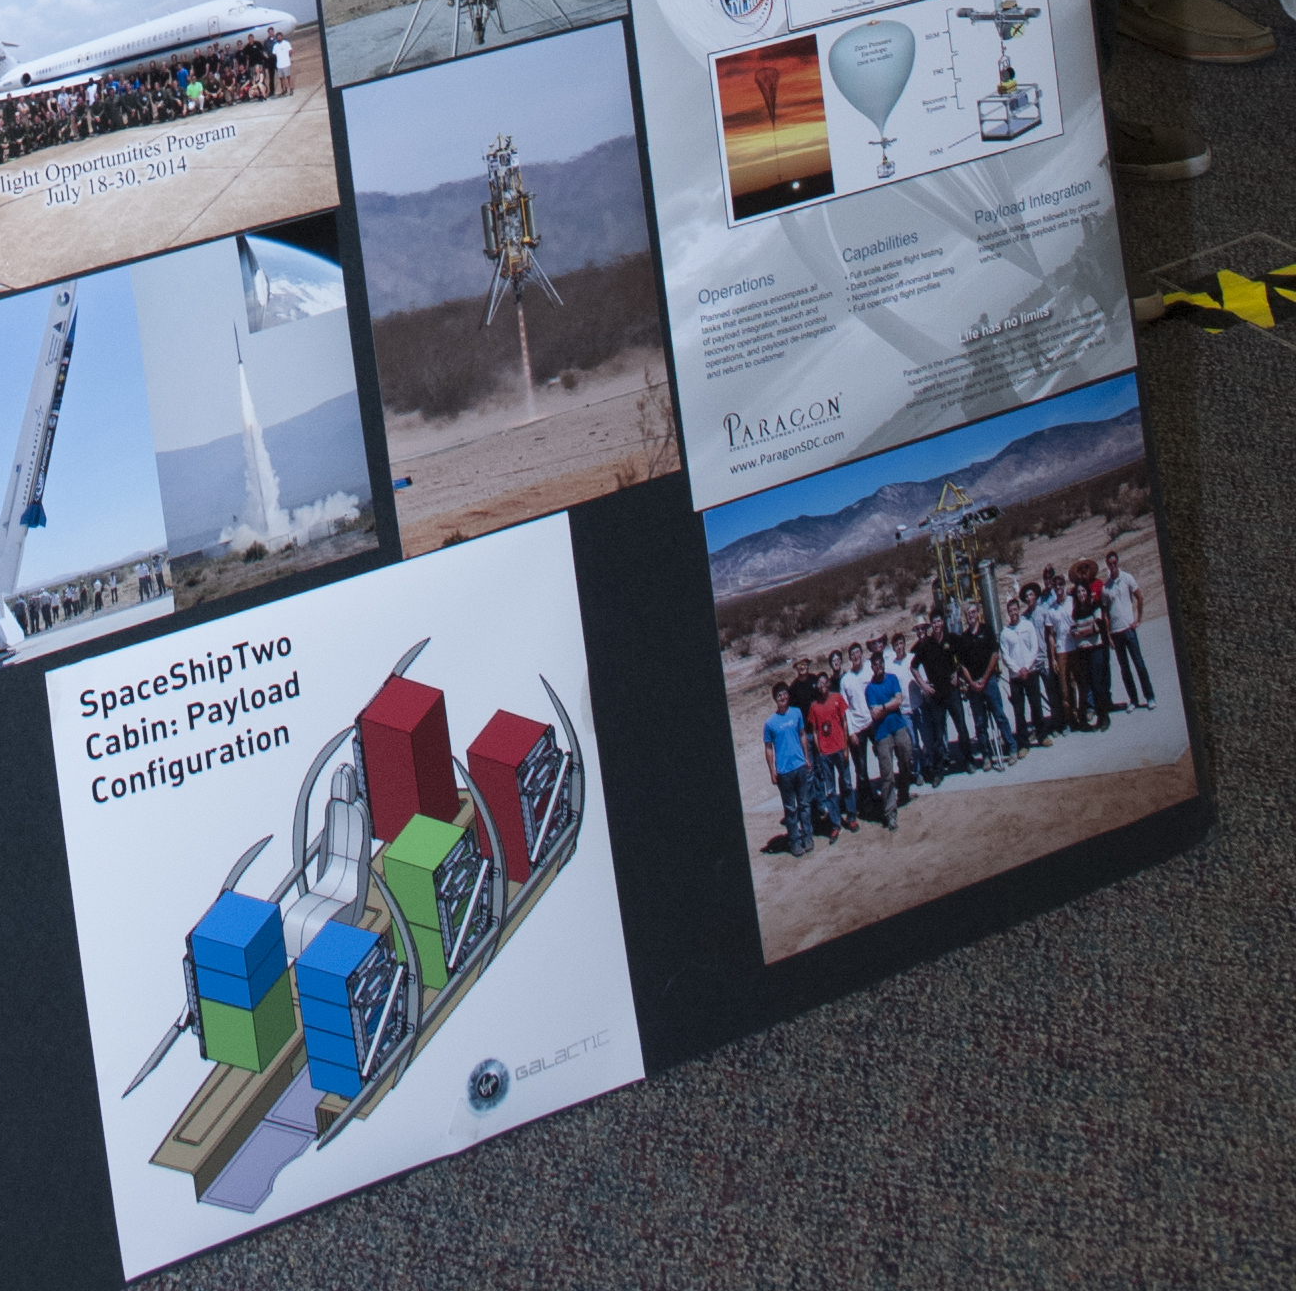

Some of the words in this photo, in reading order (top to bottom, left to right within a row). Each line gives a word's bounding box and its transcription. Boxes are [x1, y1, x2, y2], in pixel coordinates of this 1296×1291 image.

[45, 141, 161, 184] Opportunities
[166, 125, 235, 152] Program
[47, 181, 83, 208] July
[89, 168, 140, 194] 18-30,
[146, 155, 186, 180] 2014
[974, 197, 1025, 224] Payload
[1028, 180, 1091, 208] Integration
[842, 231, 918, 262] Capabilities
[697, 274, 775, 304] Operations
[958, 327, 980, 344] Life
[980, 318, 1001, 336] has
[1003, 317, 1017, 329] no
[1019, 303, 1050, 324] limits
[723, 395, 840, 447] PARAGON
[729, 431, 844, 474] www.ParagonSDC.com
[79, 636, 291, 719] SpaceShipTwo
[86, 717, 177, 760] Cabin:
[186, 670, 299, 730] Payload
[91, 725, 289, 803] Configuration
[515, 1028, 610, 1081] GALACTIC
